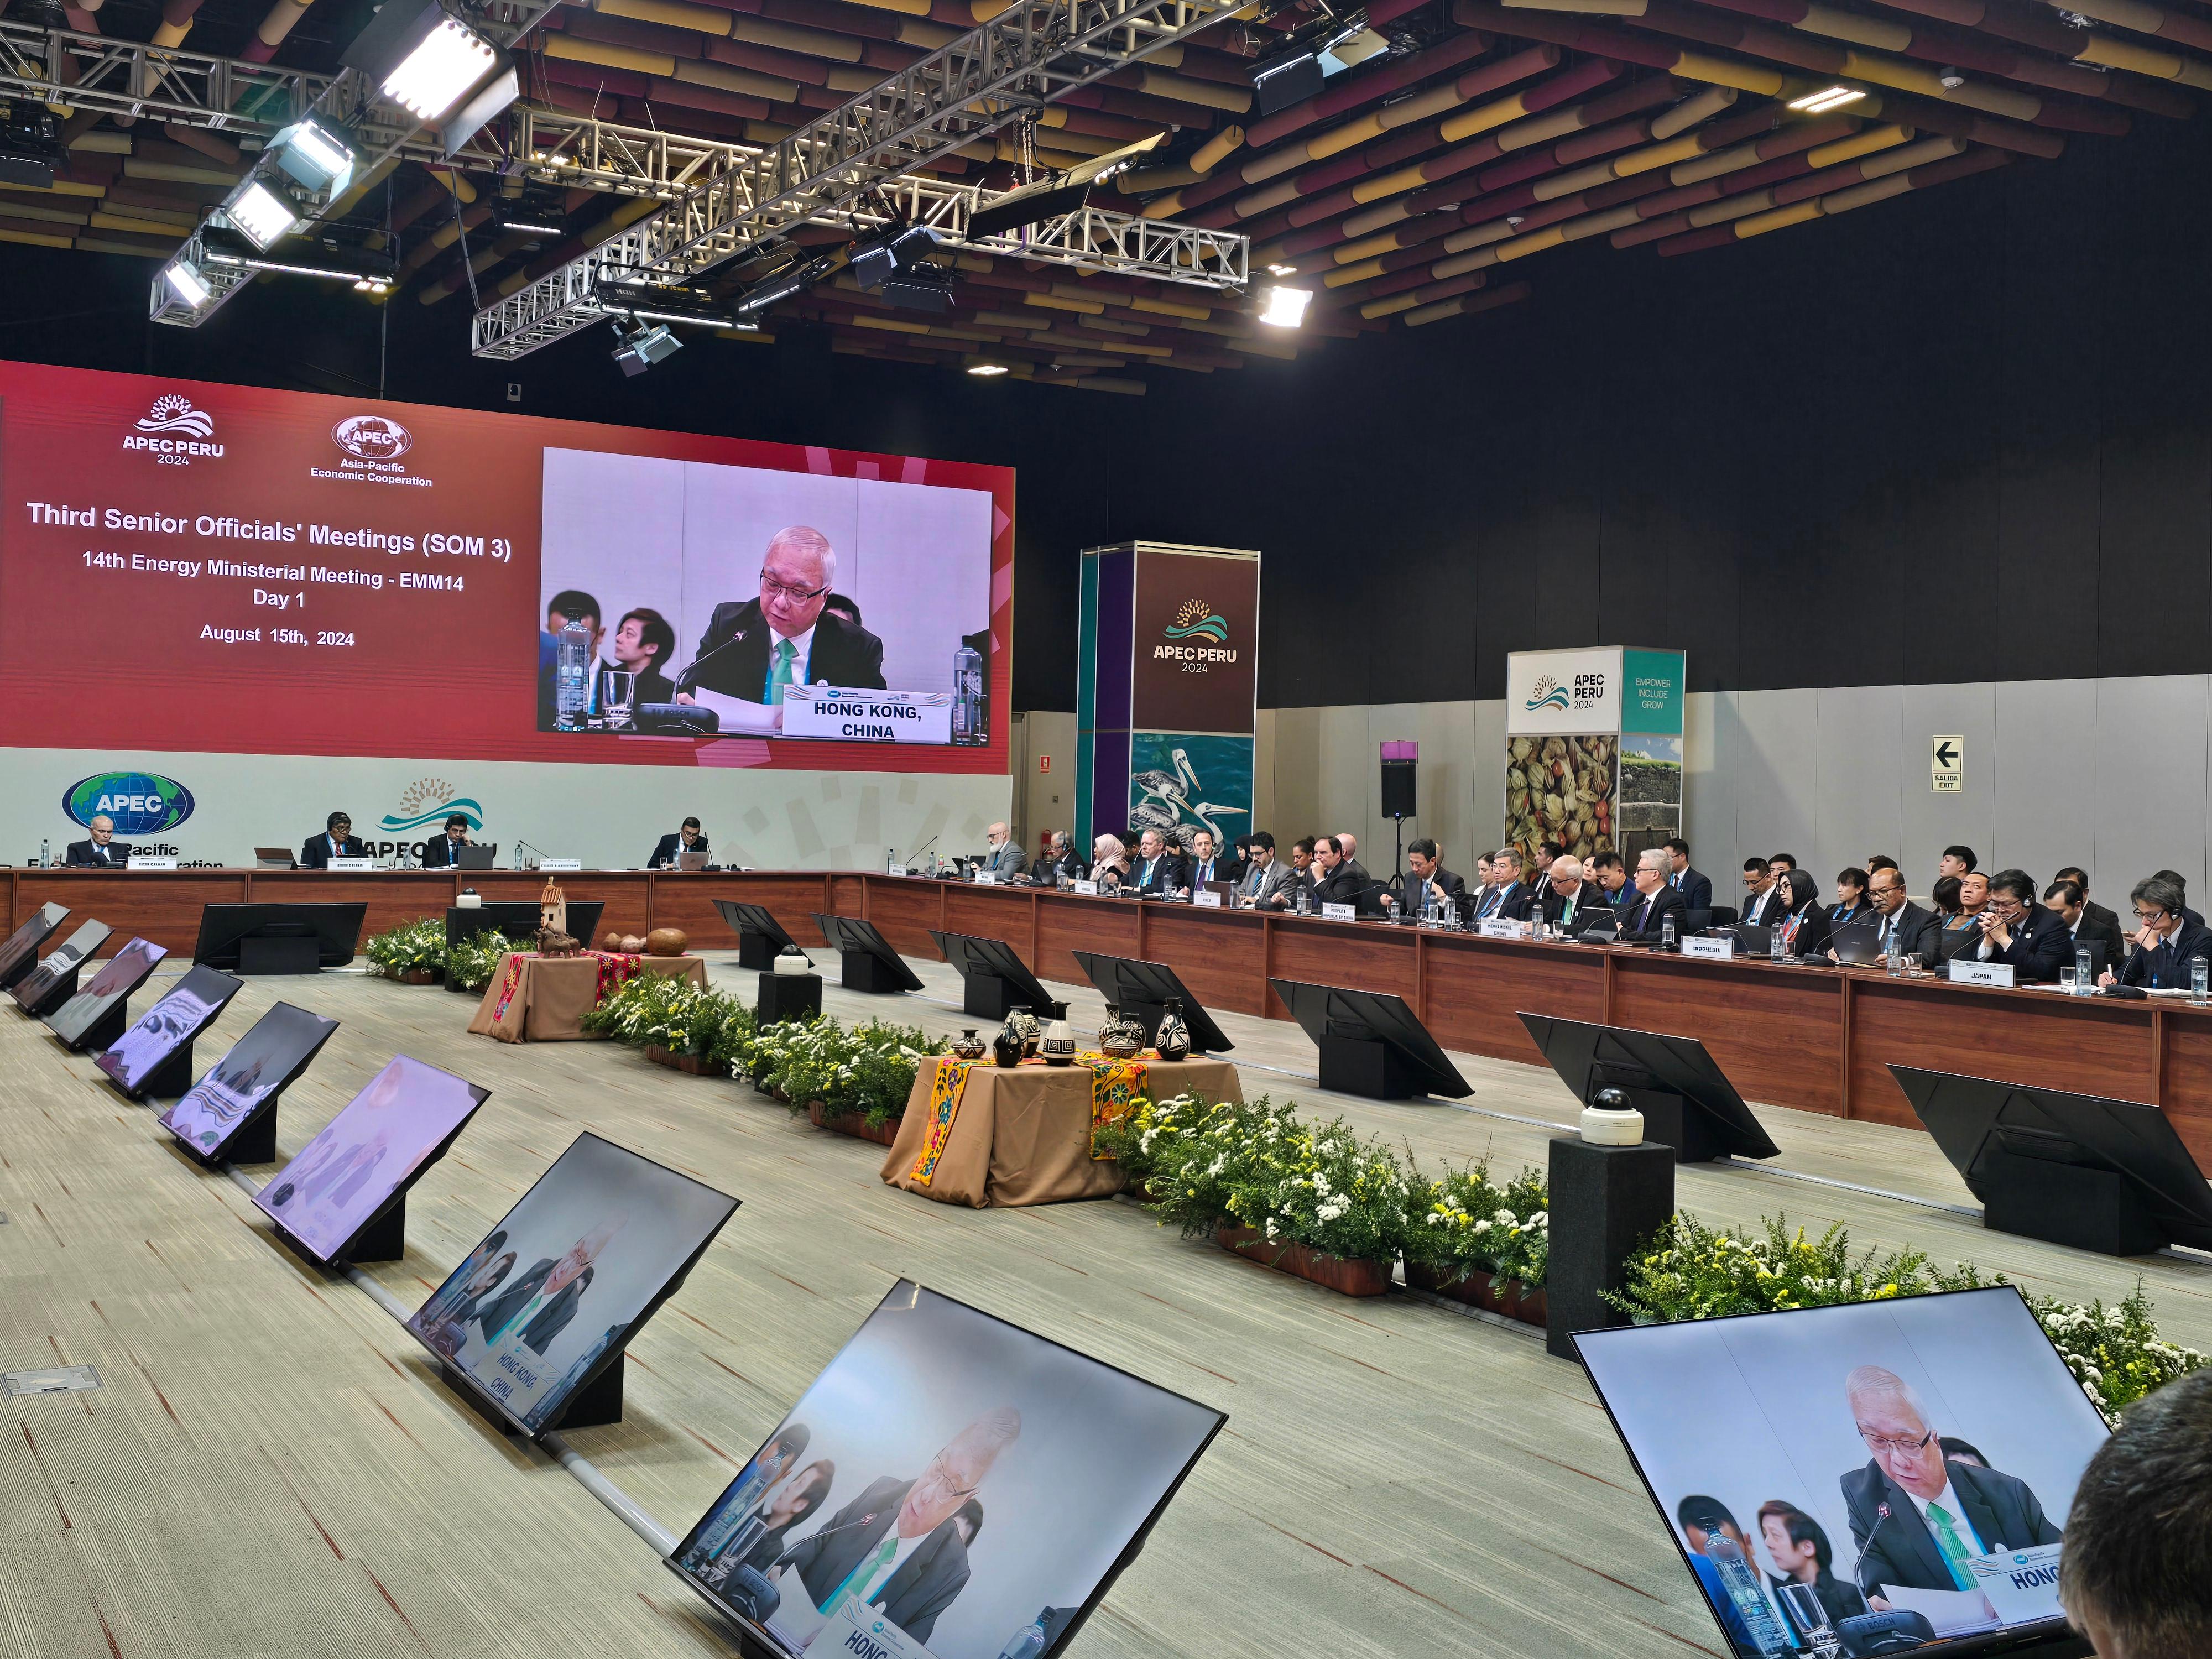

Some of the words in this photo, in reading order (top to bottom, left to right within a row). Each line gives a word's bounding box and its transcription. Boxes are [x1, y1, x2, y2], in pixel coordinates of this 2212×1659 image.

[352, 431, 392, 444] APEC
[123, 436, 174, 452] APEC
[176, 440, 223, 457] PERU
[157, 453, 189, 466] 2024
[341, 458, 405, 473] Asia-Pacific
[311, 468, 364, 481] Economic
[367, 473, 432, 487] Cooperation
[26, 502, 95, 527] Third
[104, 508, 188, 534] Senior
[196, 515, 302, 542] Officials'
[309, 524, 415, 555] Meetings
[422, 533, 484, 557] (SOM
[491, 538, 512, 563] 3)
[82, 551, 124, 568] 14th
[132, 554, 201, 577] Energy
[207, 559, 305, 581] Ministerial
[311, 566, 383, 589] Meeting
[400, 572, 463, 591] EMM14
[253, 589, 290, 610] Day
[296, 592, 304, 607] 1
[200, 624, 261, 643] August
[270, 628, 308, 646] 15th,
[317, 631, 355, 646] 2024
[1154, 645, 1195, 661] APEC
[1197, 648, 1237, 663] PERU
[1181, 662, 1208, 674] 2024
[1575, 674, 1604, 686] APEC
[1636, 678, 1671, 688] EMPOWER
[1575, 687, 1603, 699] PERU
[1638, 689, 1668, 698] INCLUDE
[815, 702, 863, 716] HONG
[869, 705, 921, 721] KONG,
[1574, 700, 1593, 709] 2024
[1641, 700, 1663, 709] GROW
[842, 723, 895, 738] CHINA
[95, 795, 161, 812] APEC
[127, 843, 179, 856] Pacific
[497, 1353, 520, 1373] HONG
[514, 1366, 537, 1391] KONG,
[491, 1377, 514, 1400] CHINA
[1867, 1618, 1896, 1629] BOSCH
